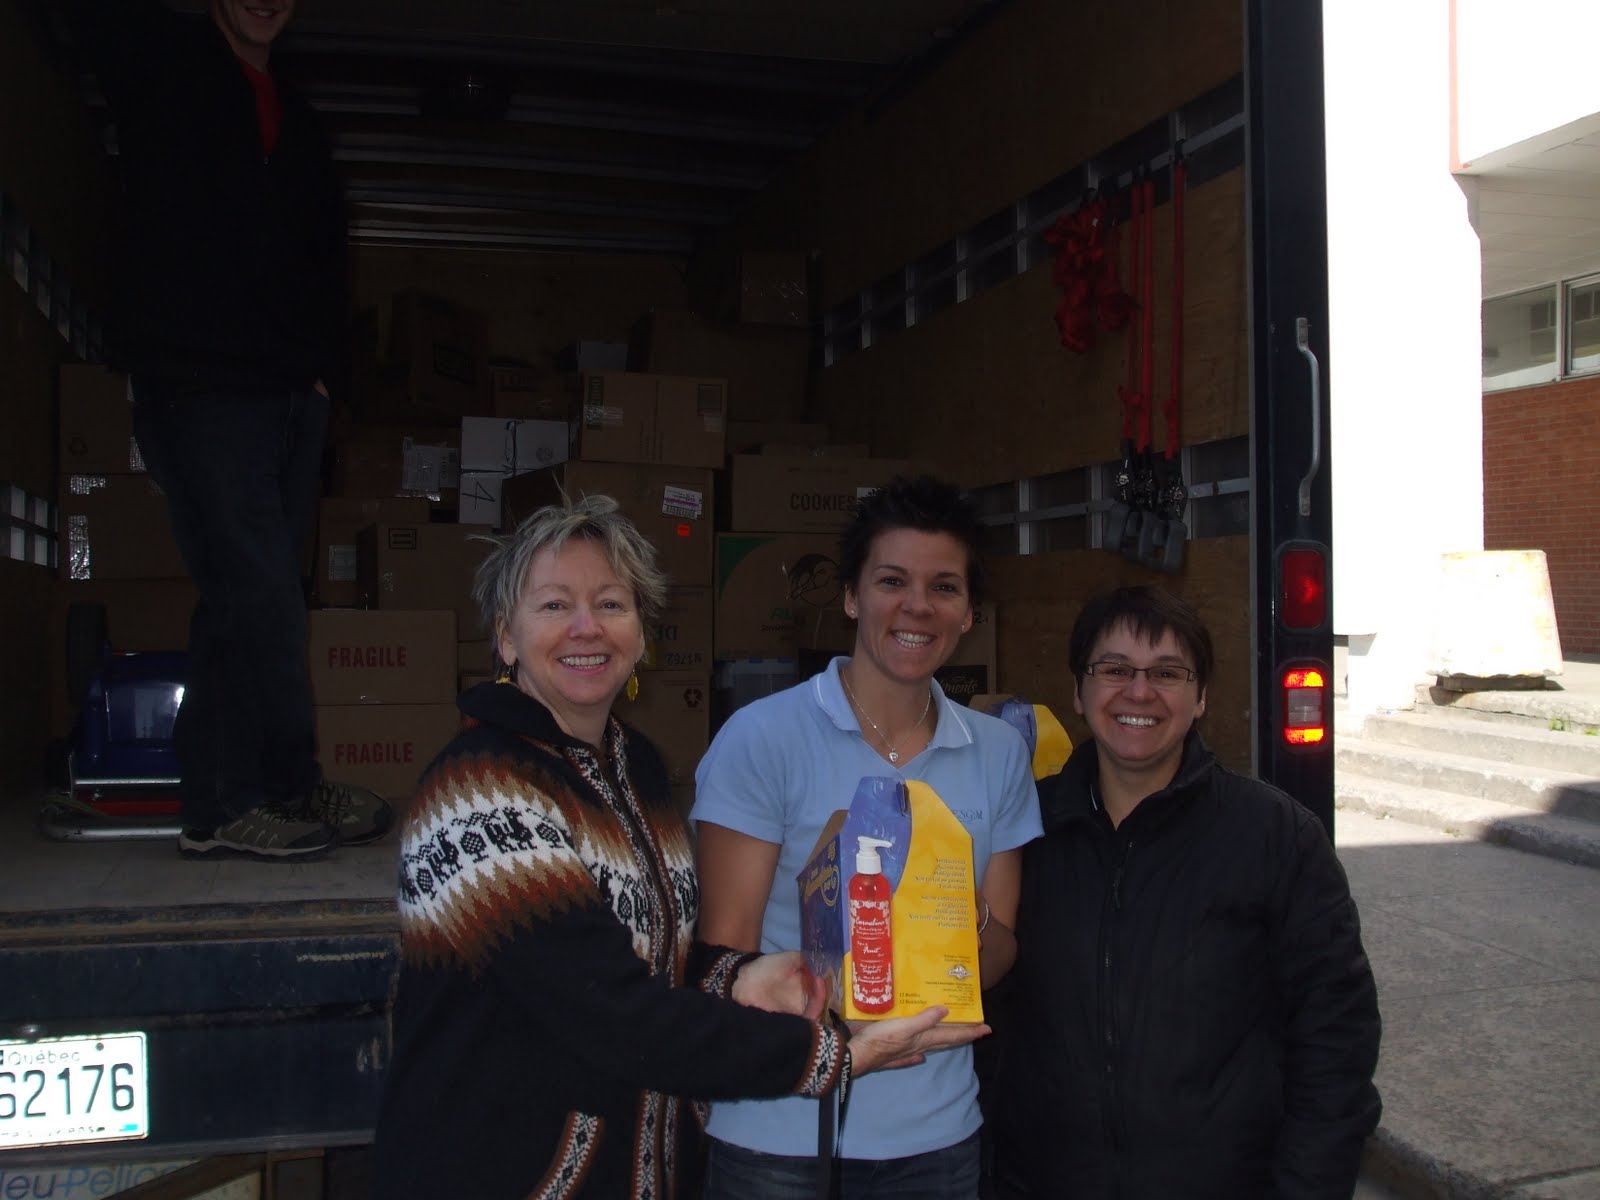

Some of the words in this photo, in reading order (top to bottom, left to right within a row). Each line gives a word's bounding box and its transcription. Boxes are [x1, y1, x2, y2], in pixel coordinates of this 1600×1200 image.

[790, 492, 856, 512] COOKIES
[328, 646, 407, 669] FRAGILE
[335, 742, 414, 764] FRAGILE
[8, 1050, 80, 1065] Québec
